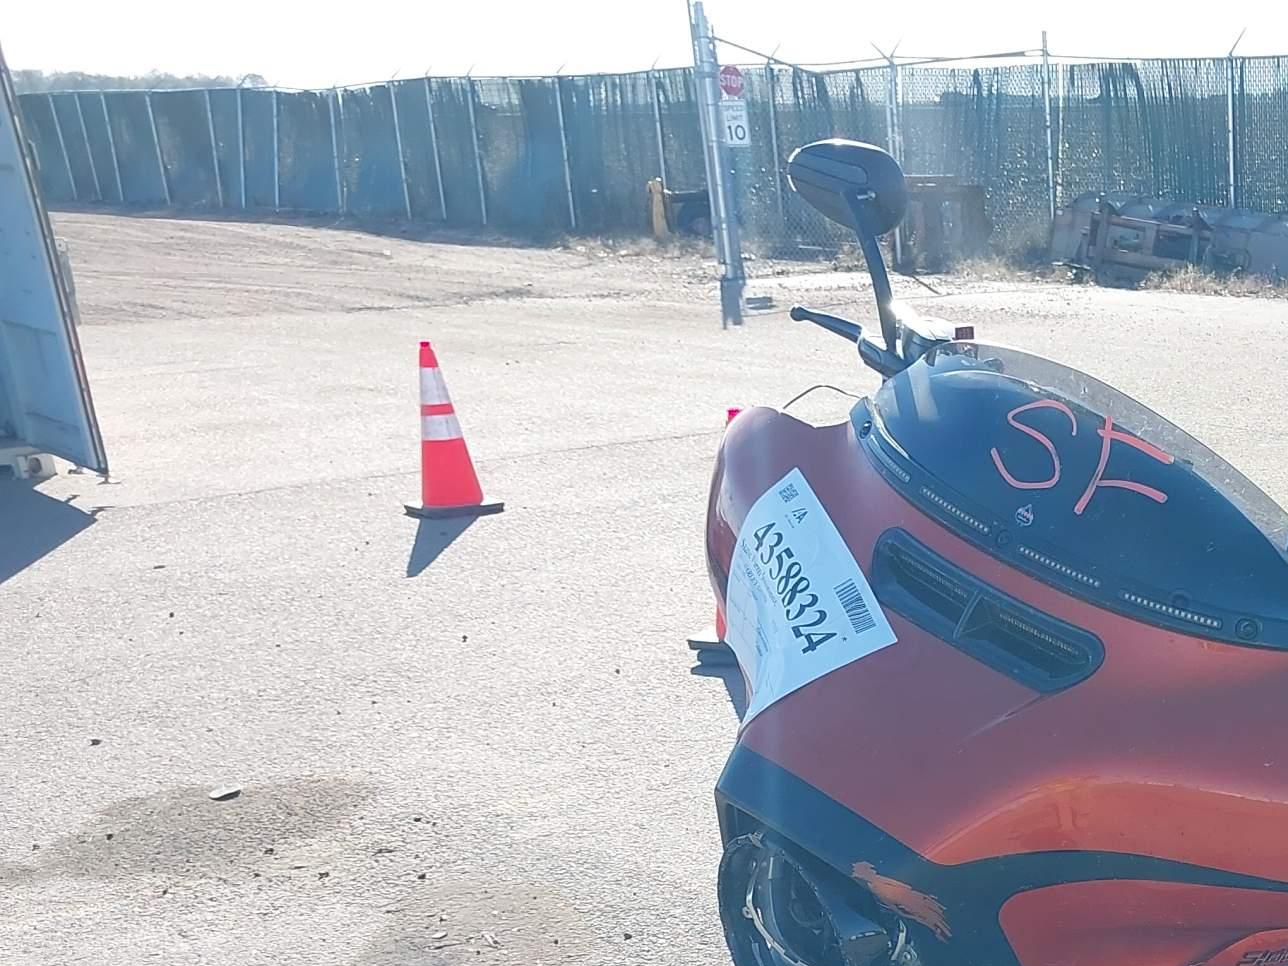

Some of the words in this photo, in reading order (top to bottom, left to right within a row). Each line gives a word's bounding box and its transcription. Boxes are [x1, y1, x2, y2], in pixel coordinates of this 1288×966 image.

[720, 73, 745, 88] STOP
[727, 124, 746, 141] 10
[753, 522, 838, 655] 43588324
